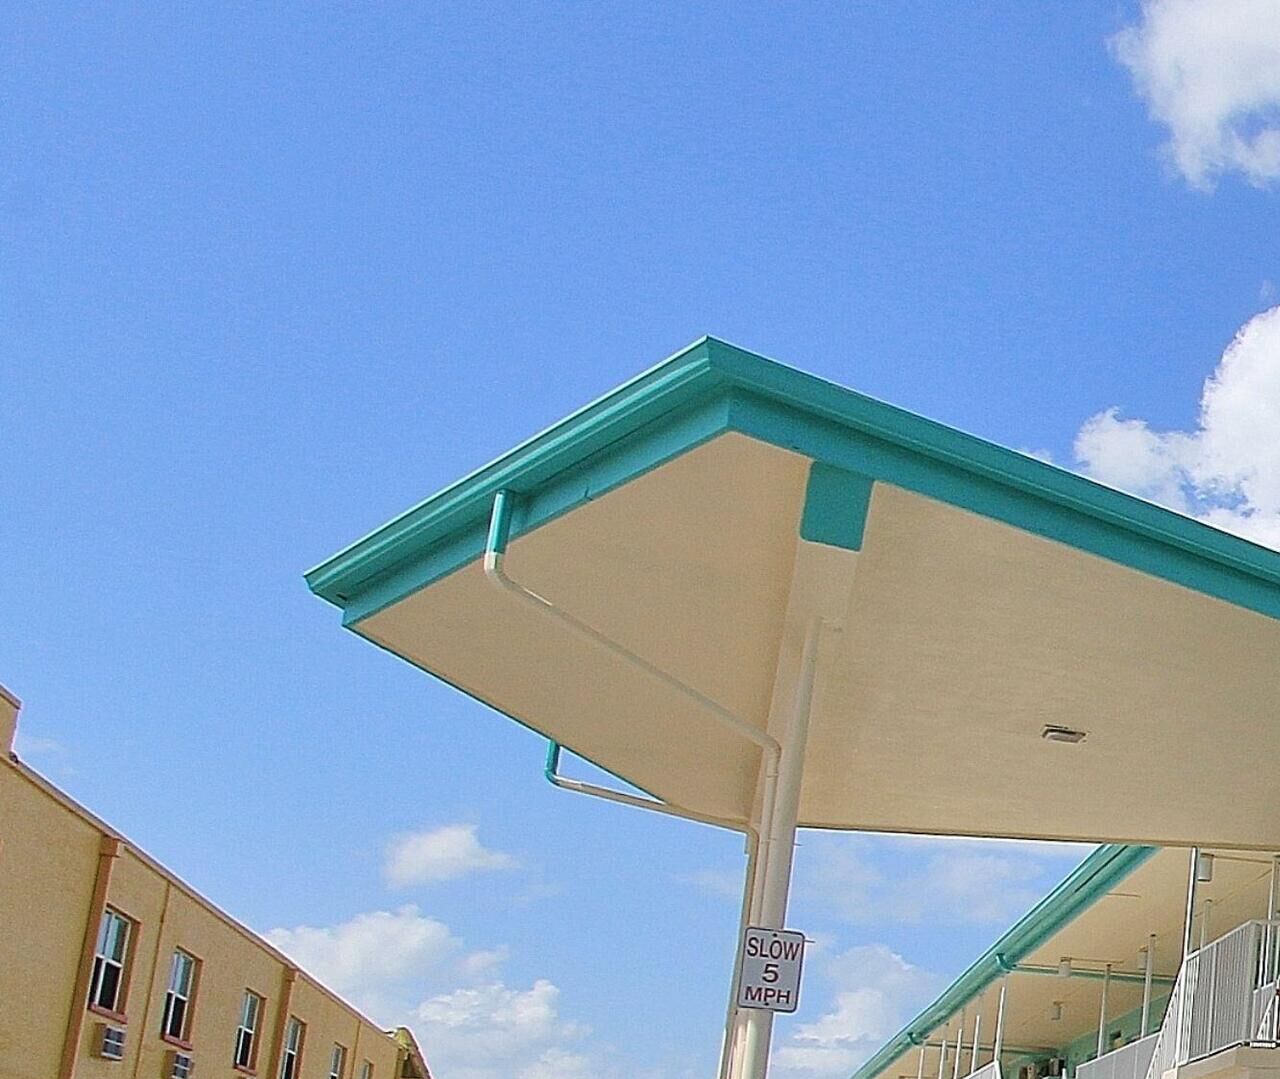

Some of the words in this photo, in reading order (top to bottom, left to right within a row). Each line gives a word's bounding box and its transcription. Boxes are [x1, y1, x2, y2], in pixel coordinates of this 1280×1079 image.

[747, 936, 800, 961] SLOW
[762, 963, 779, 983] 5
[745, 986, 791, 1004] MPH
